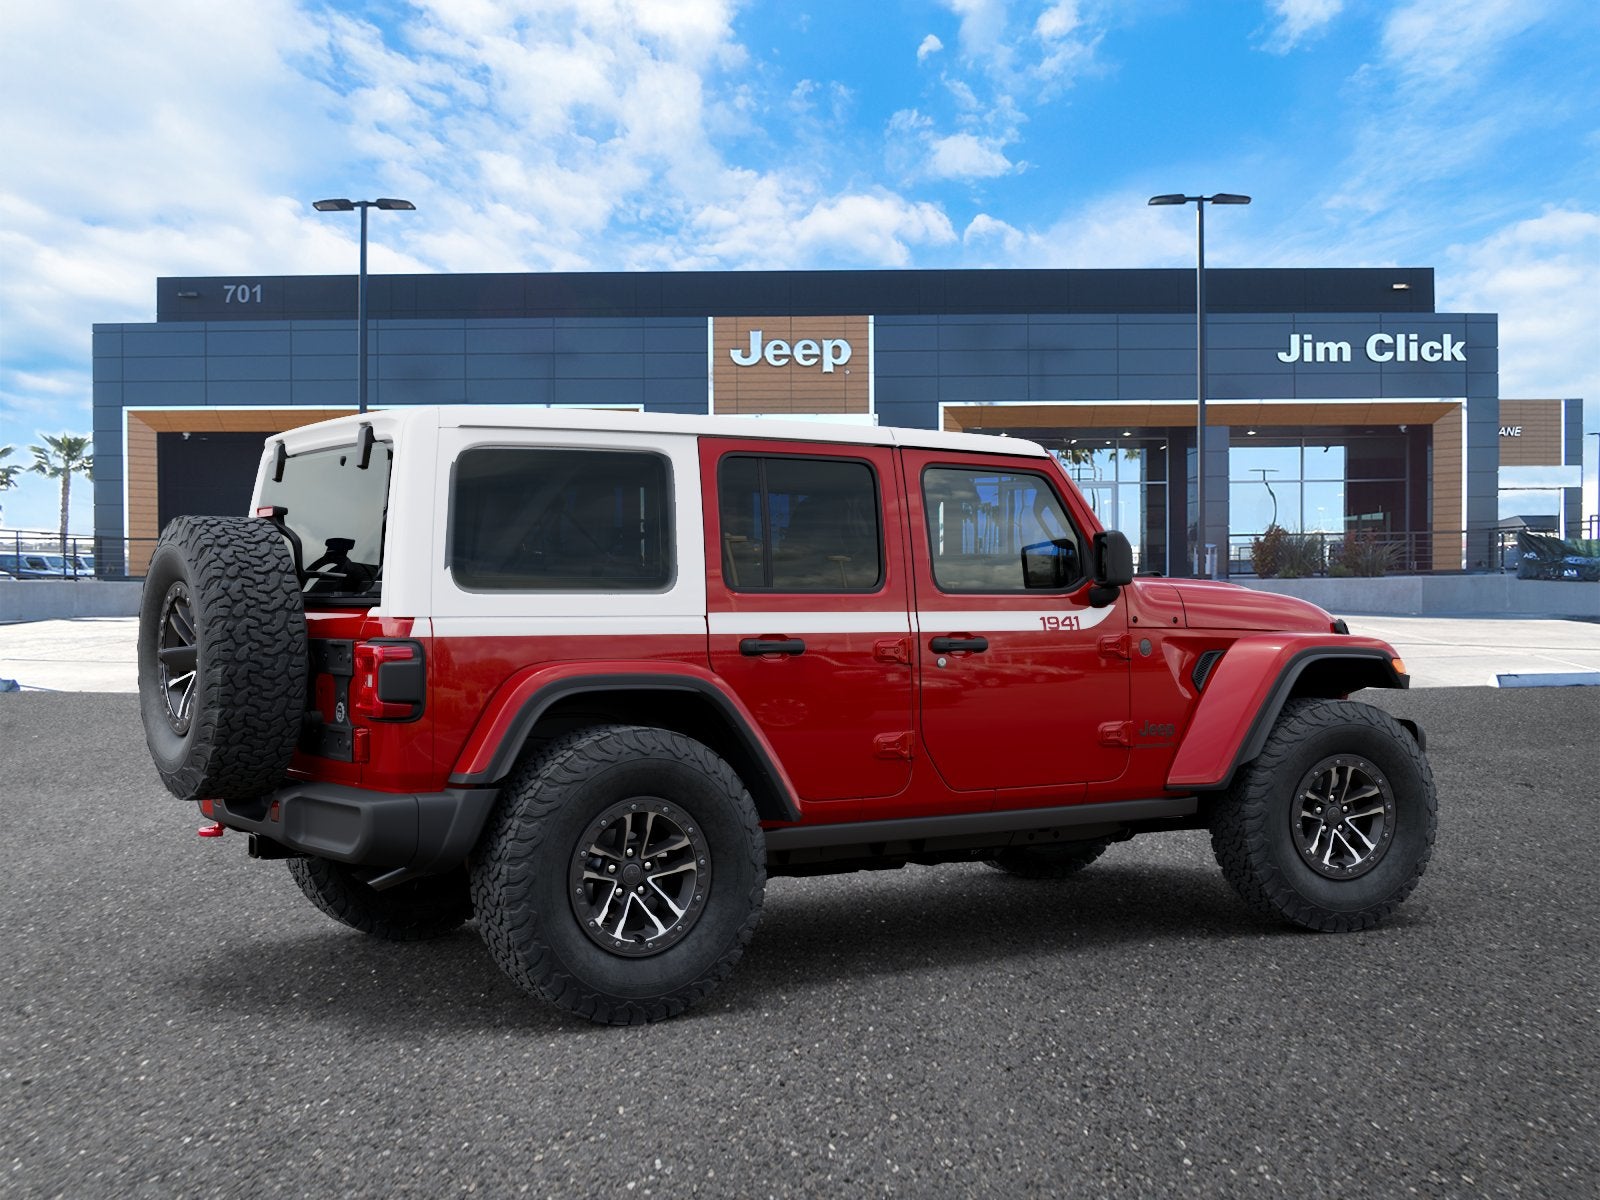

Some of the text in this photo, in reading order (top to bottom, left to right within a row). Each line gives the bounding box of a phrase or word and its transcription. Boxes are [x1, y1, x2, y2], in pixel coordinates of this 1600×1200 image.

[223, 284, 262, 304] 701
[729, 330, 852, 374] Jeep
[1277, 333, 1467, 363] Jim Click
[1039, 615, 1081, 631] 1941
[1138, 719, 1175, 740] Jeep
